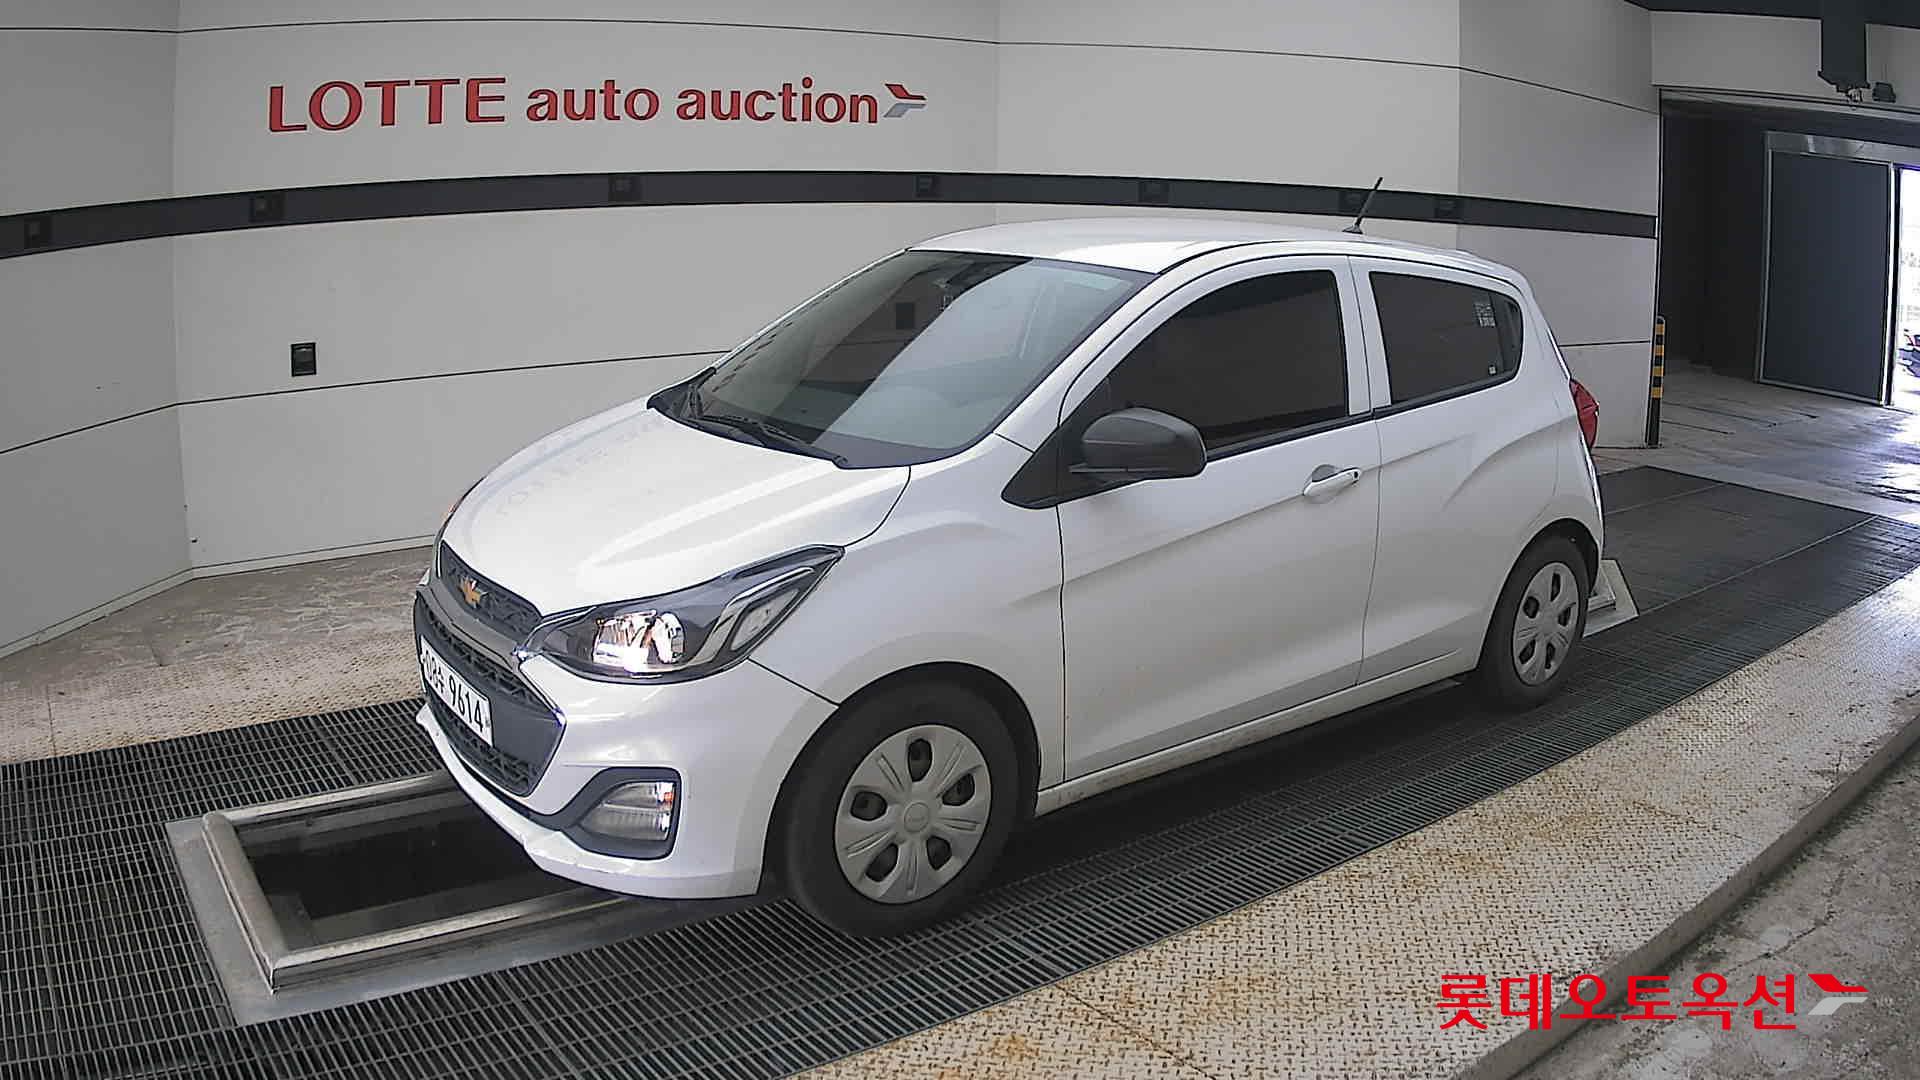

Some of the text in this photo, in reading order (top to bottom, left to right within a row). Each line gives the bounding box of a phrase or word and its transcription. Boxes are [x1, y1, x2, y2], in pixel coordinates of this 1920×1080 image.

[268, 76, 878, 133] LOTTE auto auction
[448, 674, 484, 733] 9614
